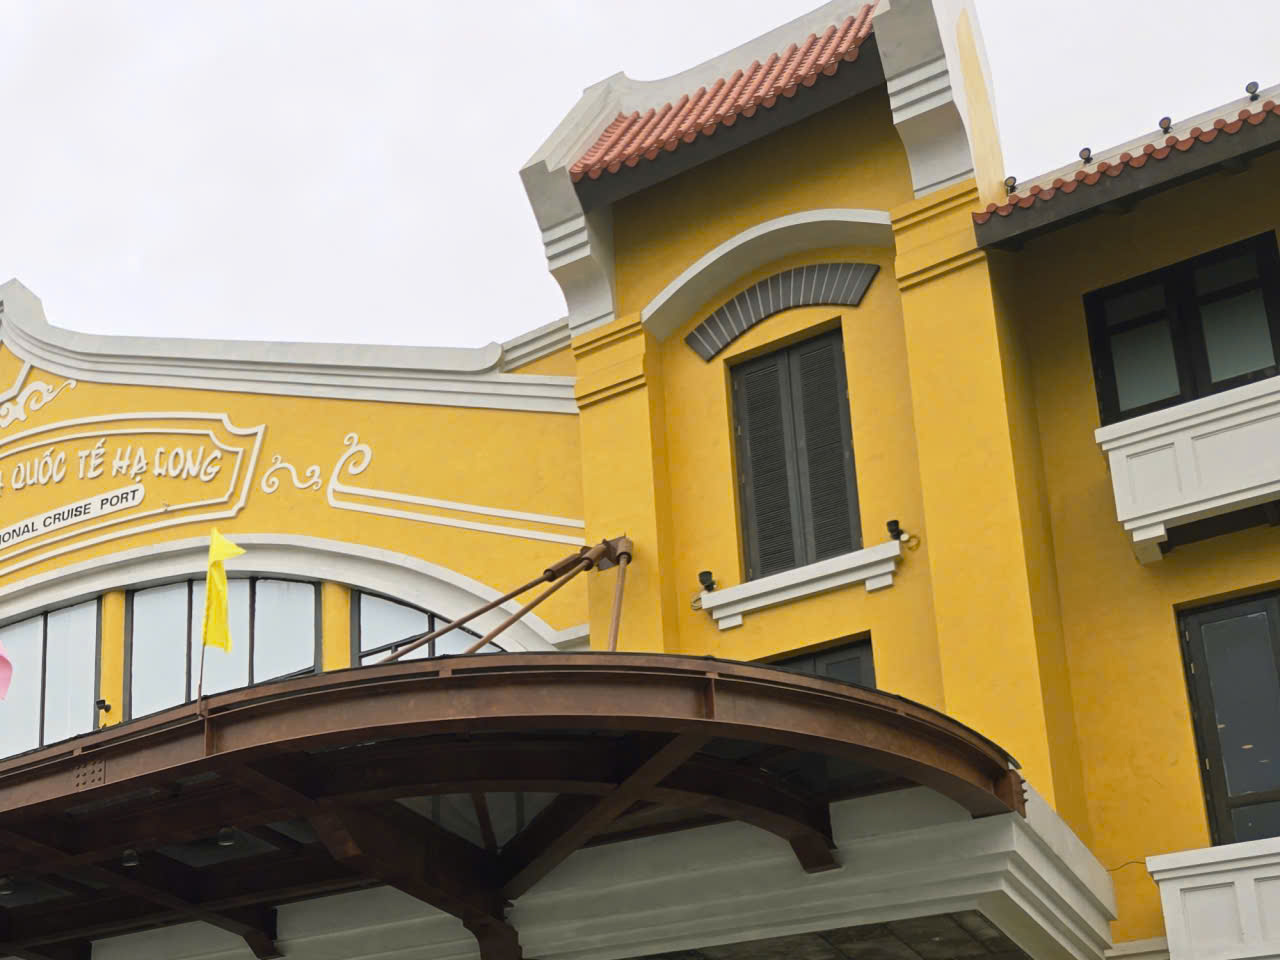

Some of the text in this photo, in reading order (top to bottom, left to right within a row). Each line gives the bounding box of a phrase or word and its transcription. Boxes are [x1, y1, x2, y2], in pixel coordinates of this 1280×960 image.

[11, 447, 67, 491] QUỐC
[78, 437, 107, 480] TẾ
[112, 445, 149, 484] HẠ
[154, 445, 223, 482] LONG
[42, 503, 92, 528] CRUISE
[100, 488, 140, 510] PORT
